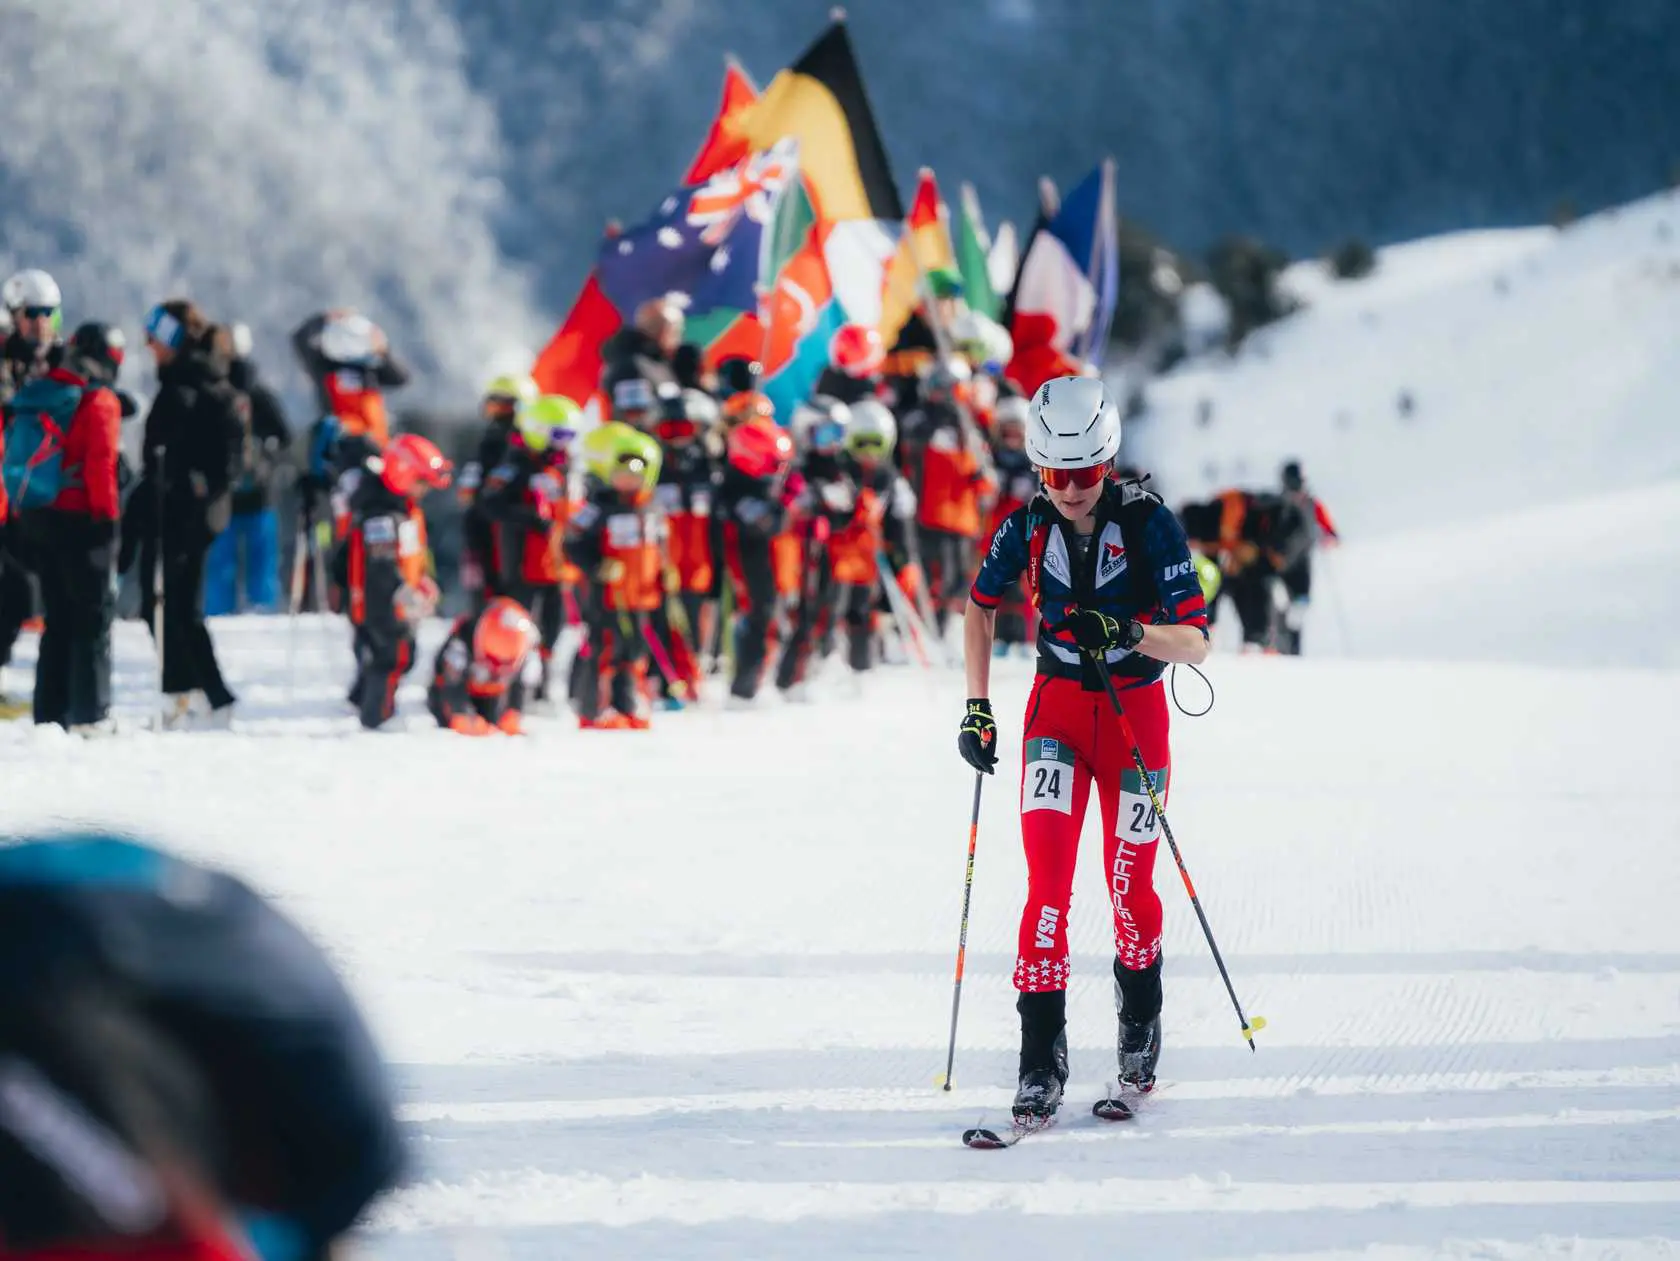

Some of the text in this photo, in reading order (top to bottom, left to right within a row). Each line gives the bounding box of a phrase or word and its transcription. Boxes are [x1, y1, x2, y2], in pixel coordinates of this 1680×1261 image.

[1034, 767, 1060, 799] 24
[1130, 803, 1157, 832] 24
[1035, 904, 1060, 949] USA
